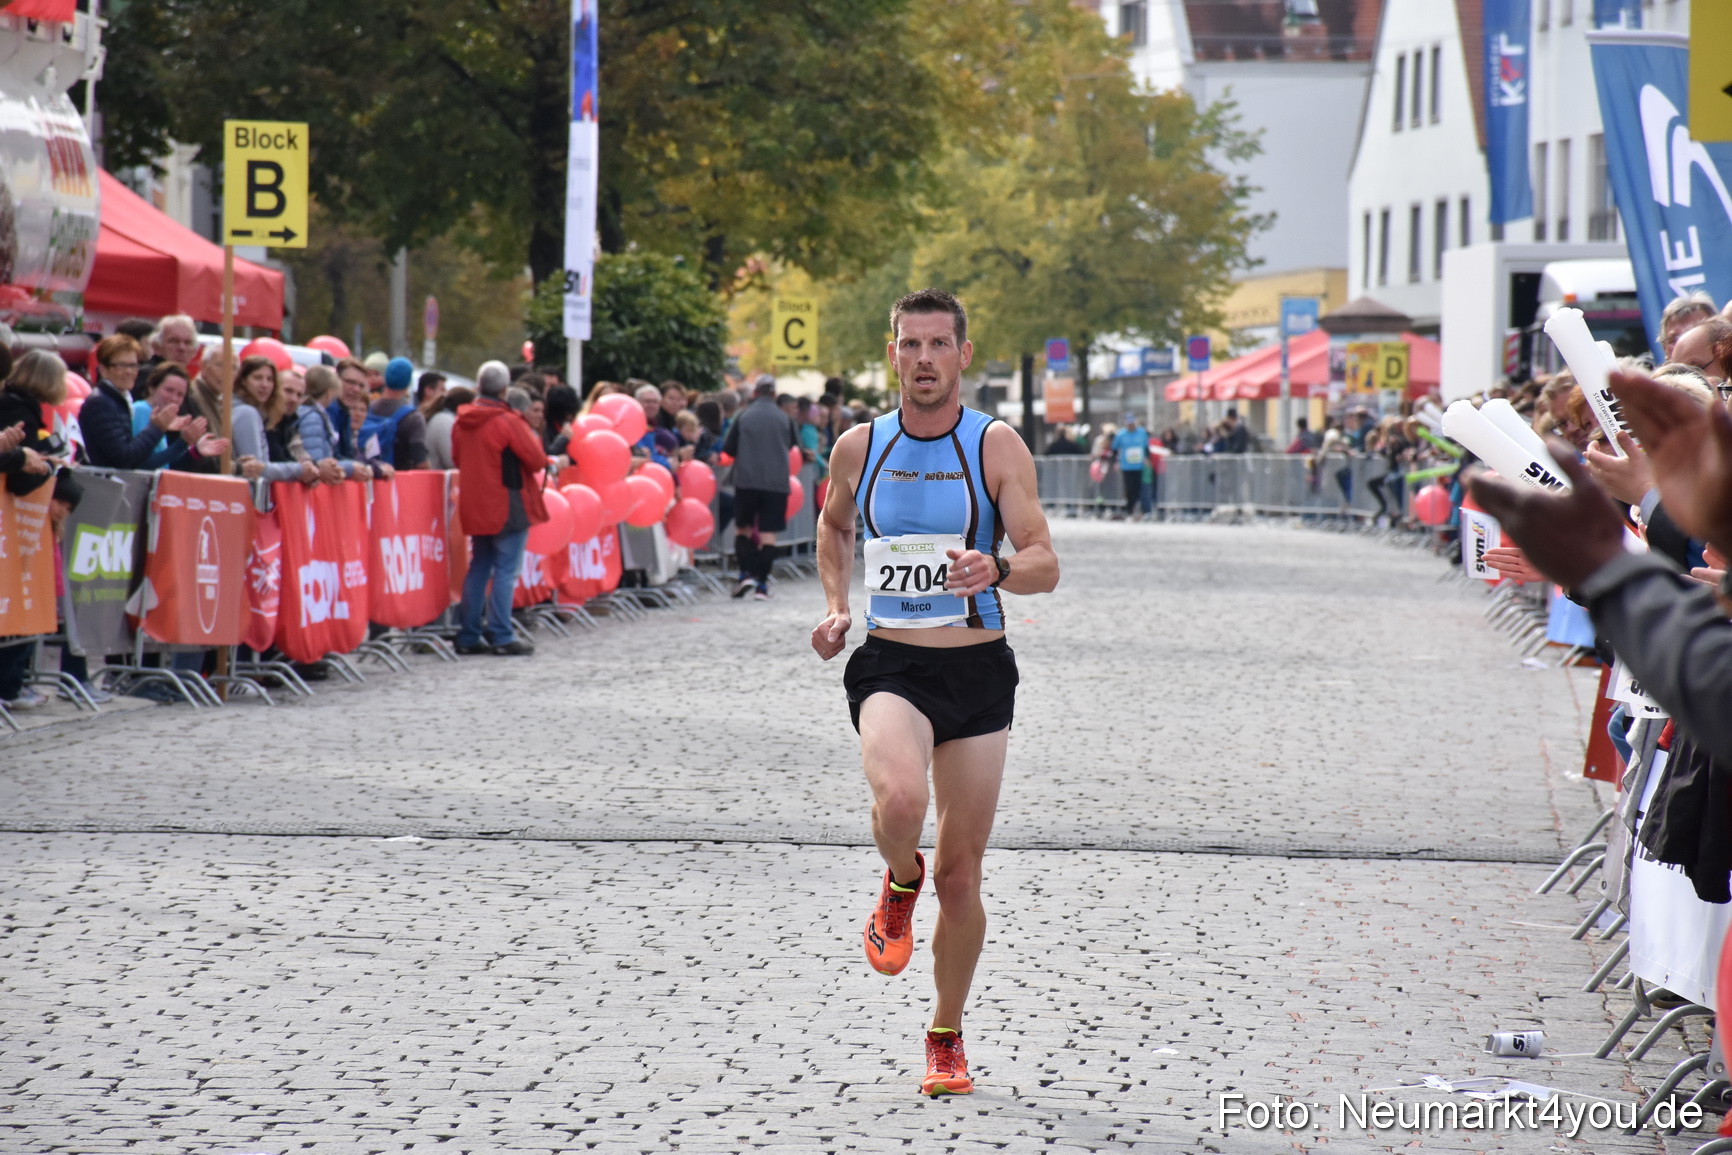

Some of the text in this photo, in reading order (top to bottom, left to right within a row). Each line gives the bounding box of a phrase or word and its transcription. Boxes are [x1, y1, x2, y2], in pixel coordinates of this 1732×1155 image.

[234, 127, 298, 150] Block
[246, 160, 287, 218] B
[783, 317, 805, 350] C
[1385, 356, 1403, 380] D
[899, 543, 935, 552] BOCK
[880, 564, 948, 592] 2704
[901, 602, 931, 612] Marco
